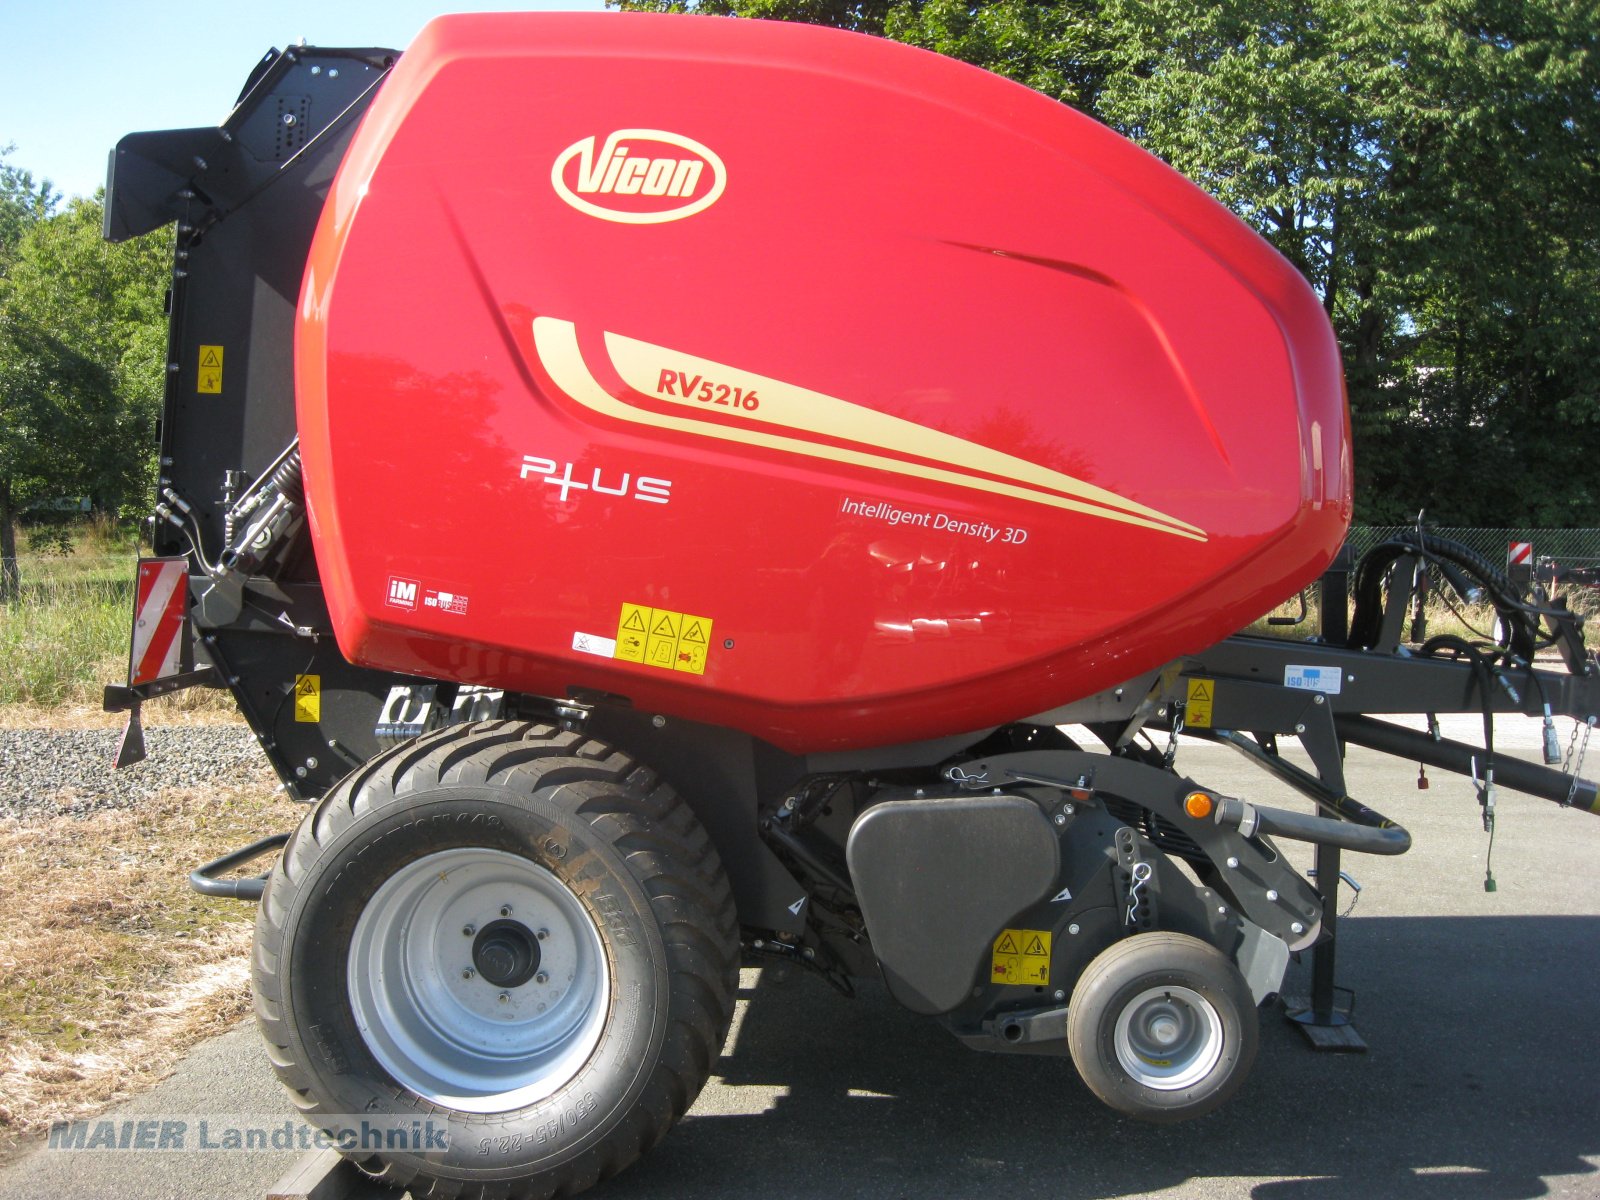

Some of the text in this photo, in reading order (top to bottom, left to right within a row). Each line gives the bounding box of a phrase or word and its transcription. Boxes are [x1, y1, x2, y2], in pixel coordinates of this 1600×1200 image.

[575, 129, 704, 198] Vicon
[656, 368, 760, 411] RV5216
[841, 497, 1028, 545] Intelligent Density 3D
[478, 1090, 598, 1156] 550/45-22.5
